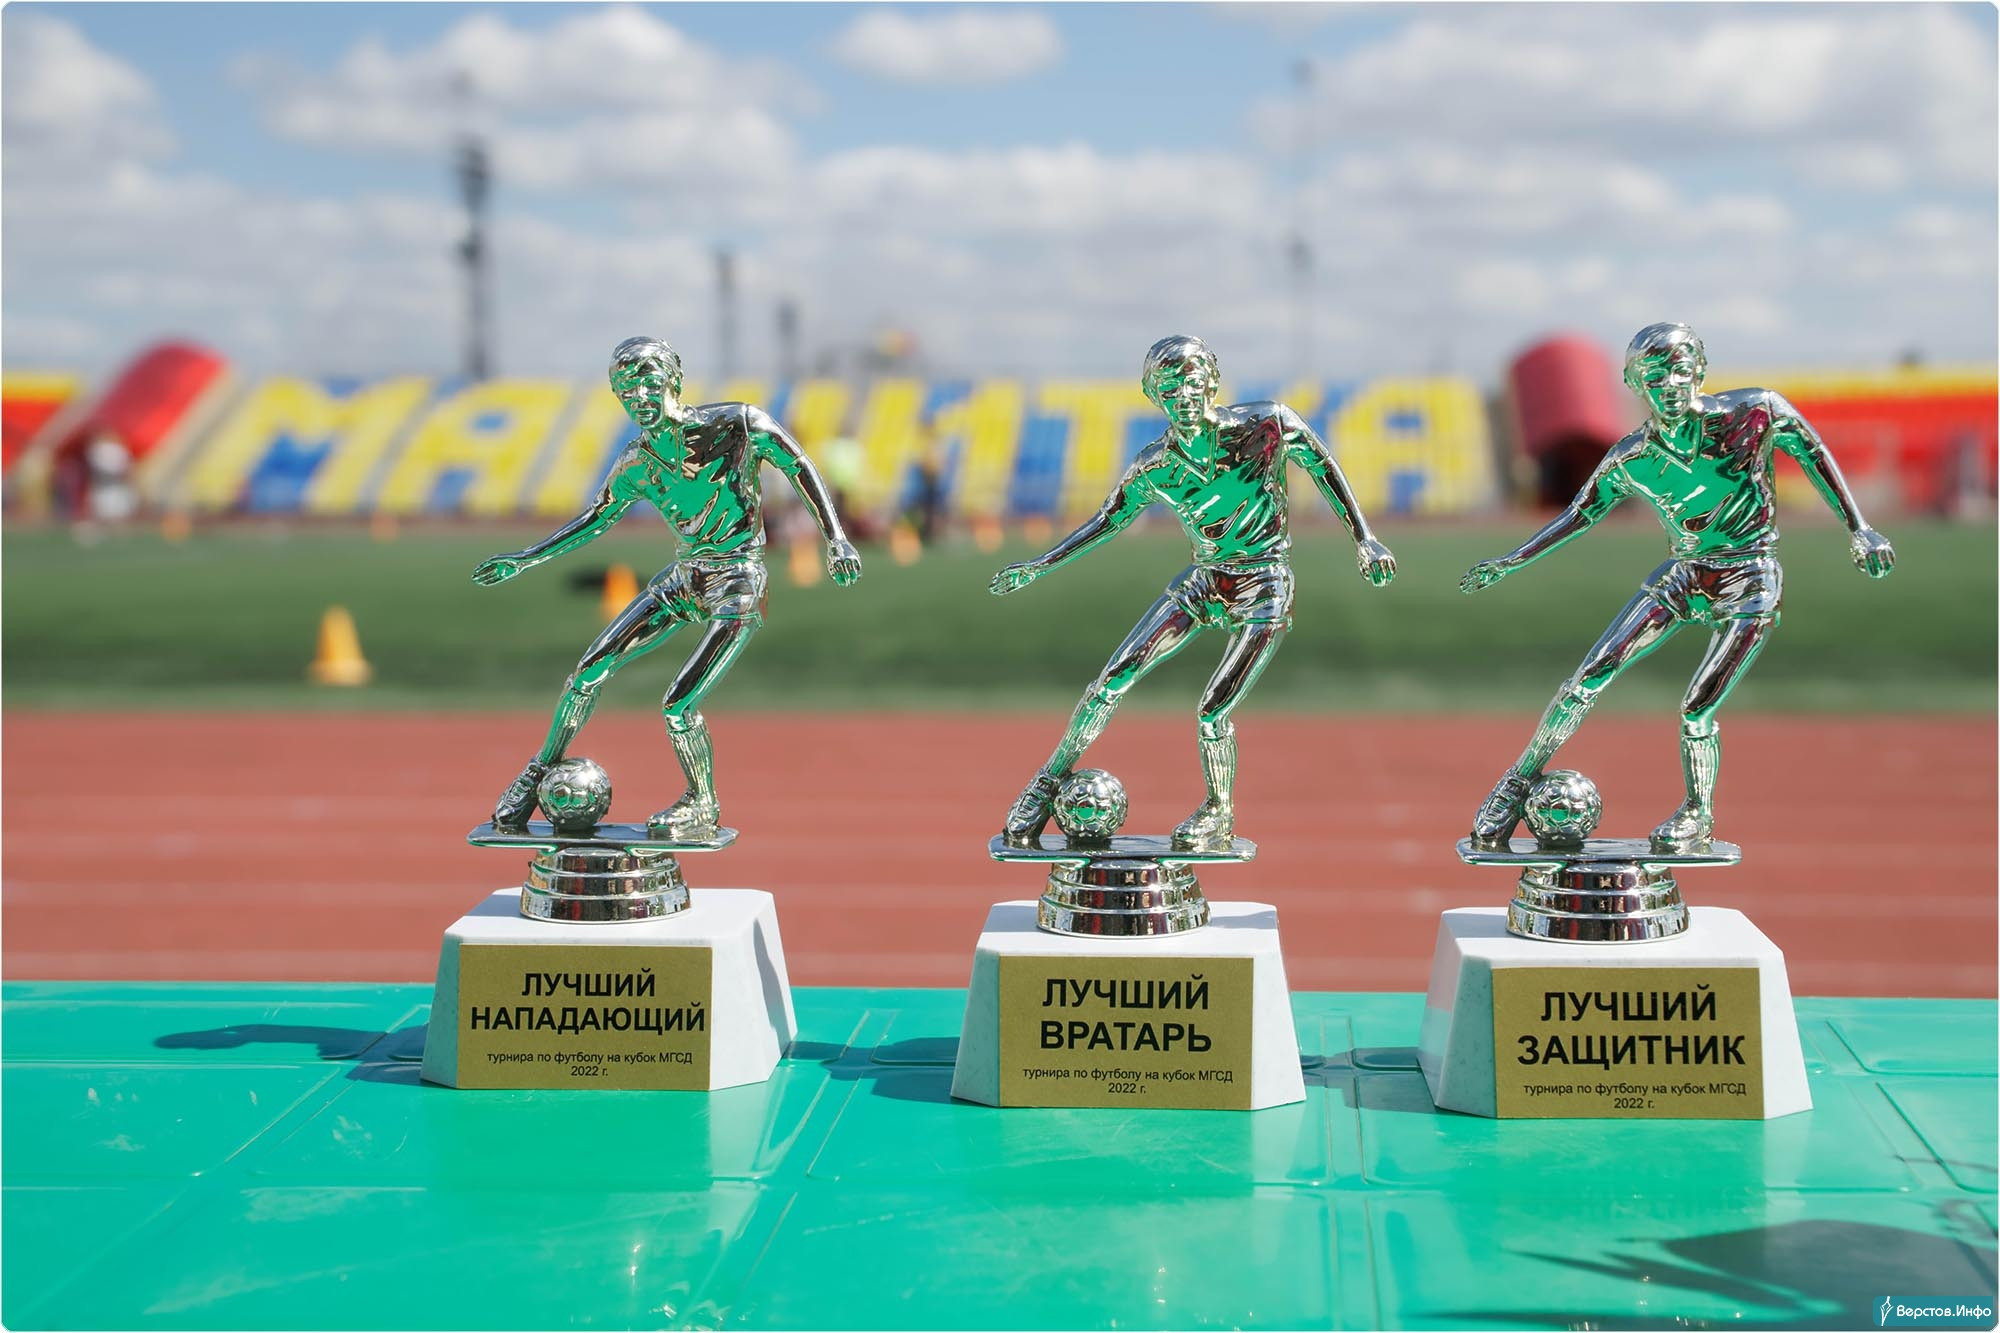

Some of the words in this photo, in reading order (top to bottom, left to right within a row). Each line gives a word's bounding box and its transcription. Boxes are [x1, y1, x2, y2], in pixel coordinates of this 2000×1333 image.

[521, 967, 656, 998] ЛУЧШИЙ
[1041, 973, 1210, 1010] ЛУЧШИЙ
[1540, 983, 1717, 1022] ЛУЧШИЙ
[470, 1001, 706, 1036] НАПАДАЮЩИЙ
[1040, 1020, 1213, 1053] ВРАТАРЬ
[487, 1052, 534, 1065] турнира
[537, 1053, 552, 1063] по
[554, 1051, 604, 1065] футболу
[607, 1053, 621, 1063] на
[624, 1052, 656, 1064] кубок
[659, 1052, 693, 1065] МГСД
[1517, 1034, 1746, 1071] ЗАЩИТНИК
[570, 1065, 599, 1077] 2022
[602, 1067, 609, 1077] г.
[1022, 1068, 1070, 1081] турнира
[1073, 1069, 1088, 1079] по
[1090, 1068, 1142, 1082] футболу
[1145, 1071, 1160, 1080] на
[1162, 1069, 1196, 1082] кубок
[1198, 1070, 1234, 1084] МГСД
[1107, 1081, 1137, 1094] 2022
[1139, 1084, 1147, 1094] г.
[1523, 1084, 1574, 1096] турнира
[1576, 1084, 1592, 1094] по
[1594, 1082, 1649, 1096] футболу
[1652, 1084, 1668, 1094] на
[1670, 1083, 1706, 1094] кубок
[1709, 1083, 1747, 1097] МГСД
[1613, 1097, 1644, 1109] 2022
[1647, 1099, 1655, 1109] г.
